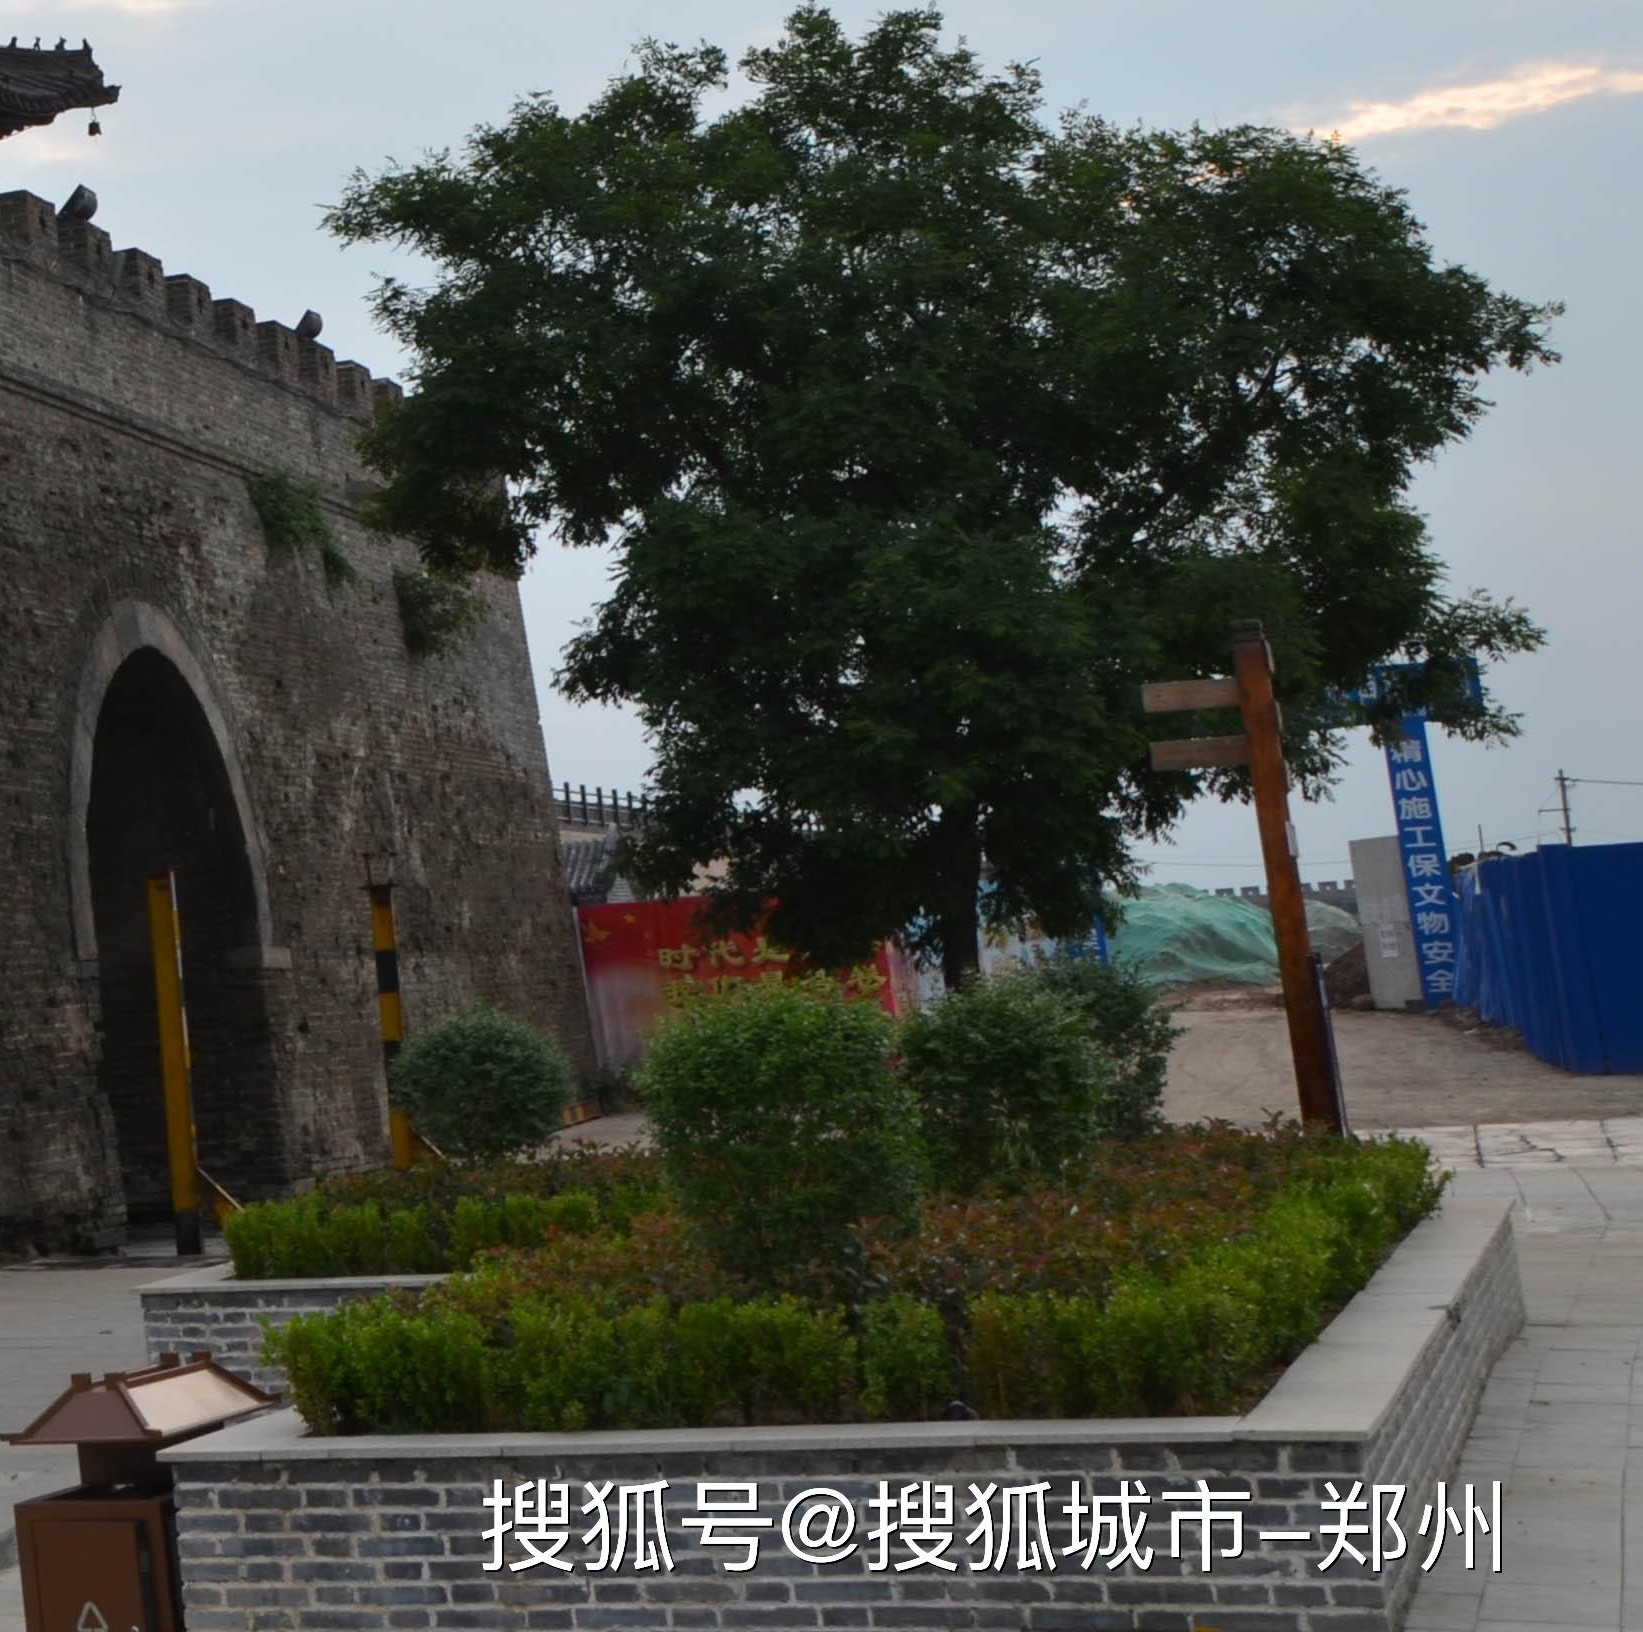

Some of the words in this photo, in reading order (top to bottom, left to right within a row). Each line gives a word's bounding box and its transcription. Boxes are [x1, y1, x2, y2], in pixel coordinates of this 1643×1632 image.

[1391, 739, 1456, 994] 精心施工保文物安全
